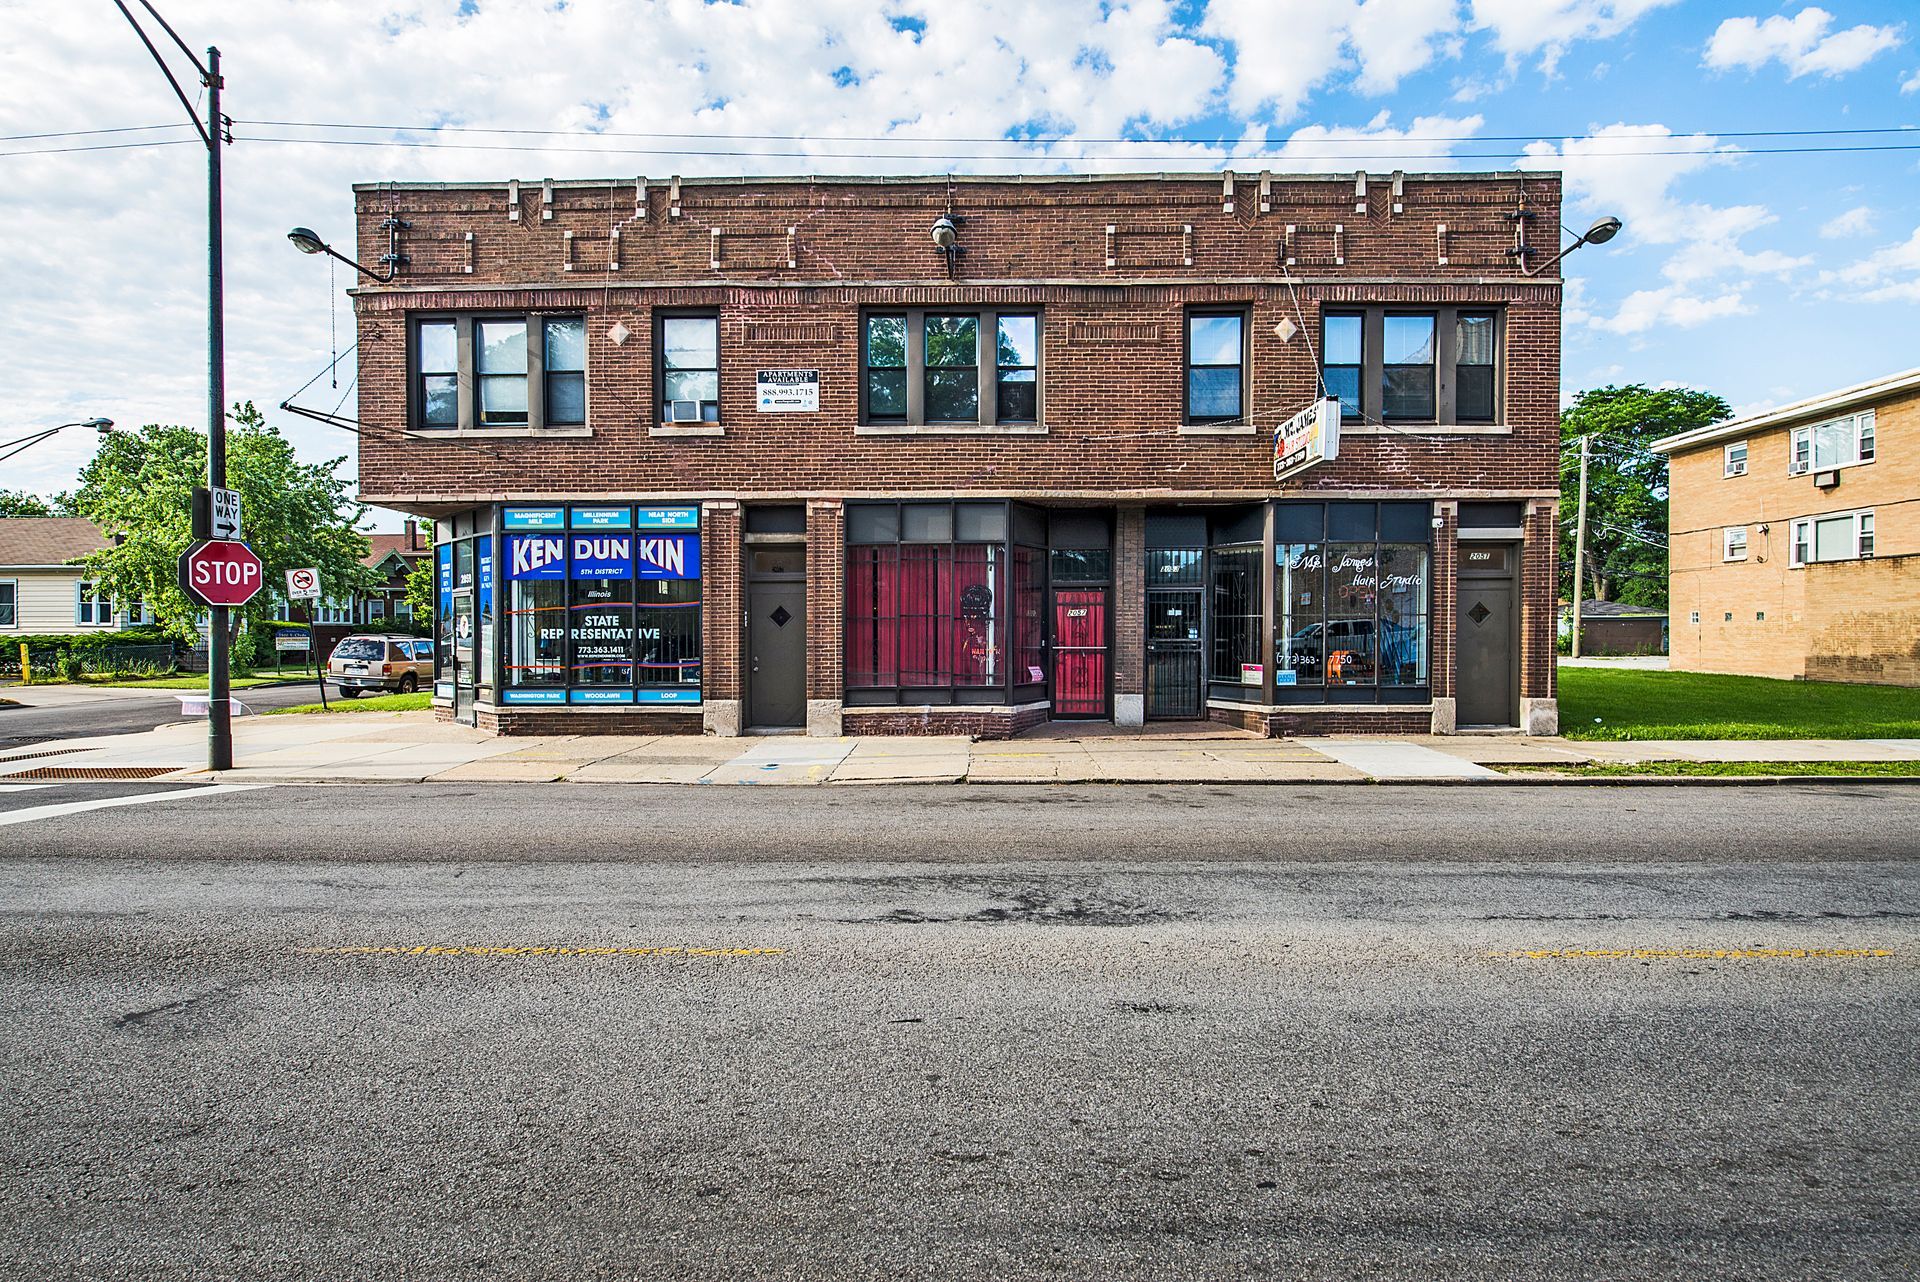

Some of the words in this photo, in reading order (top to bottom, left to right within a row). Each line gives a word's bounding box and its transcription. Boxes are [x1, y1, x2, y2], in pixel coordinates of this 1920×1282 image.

[762, 388, 814, 396] 888.993.1715
[215, 491, 238, 507] ONE
[215, 505, 238, 520] WAY
[512, 538, 564, 577] KEN
[195, 560, 258, 585] STOP
[587, 590, 612, 598] Illinois
[584, 615, 620, 627] STATE
[577, 646, 624, 654] 773.363.1411
[1328, 655, 1352, 664] 7750
